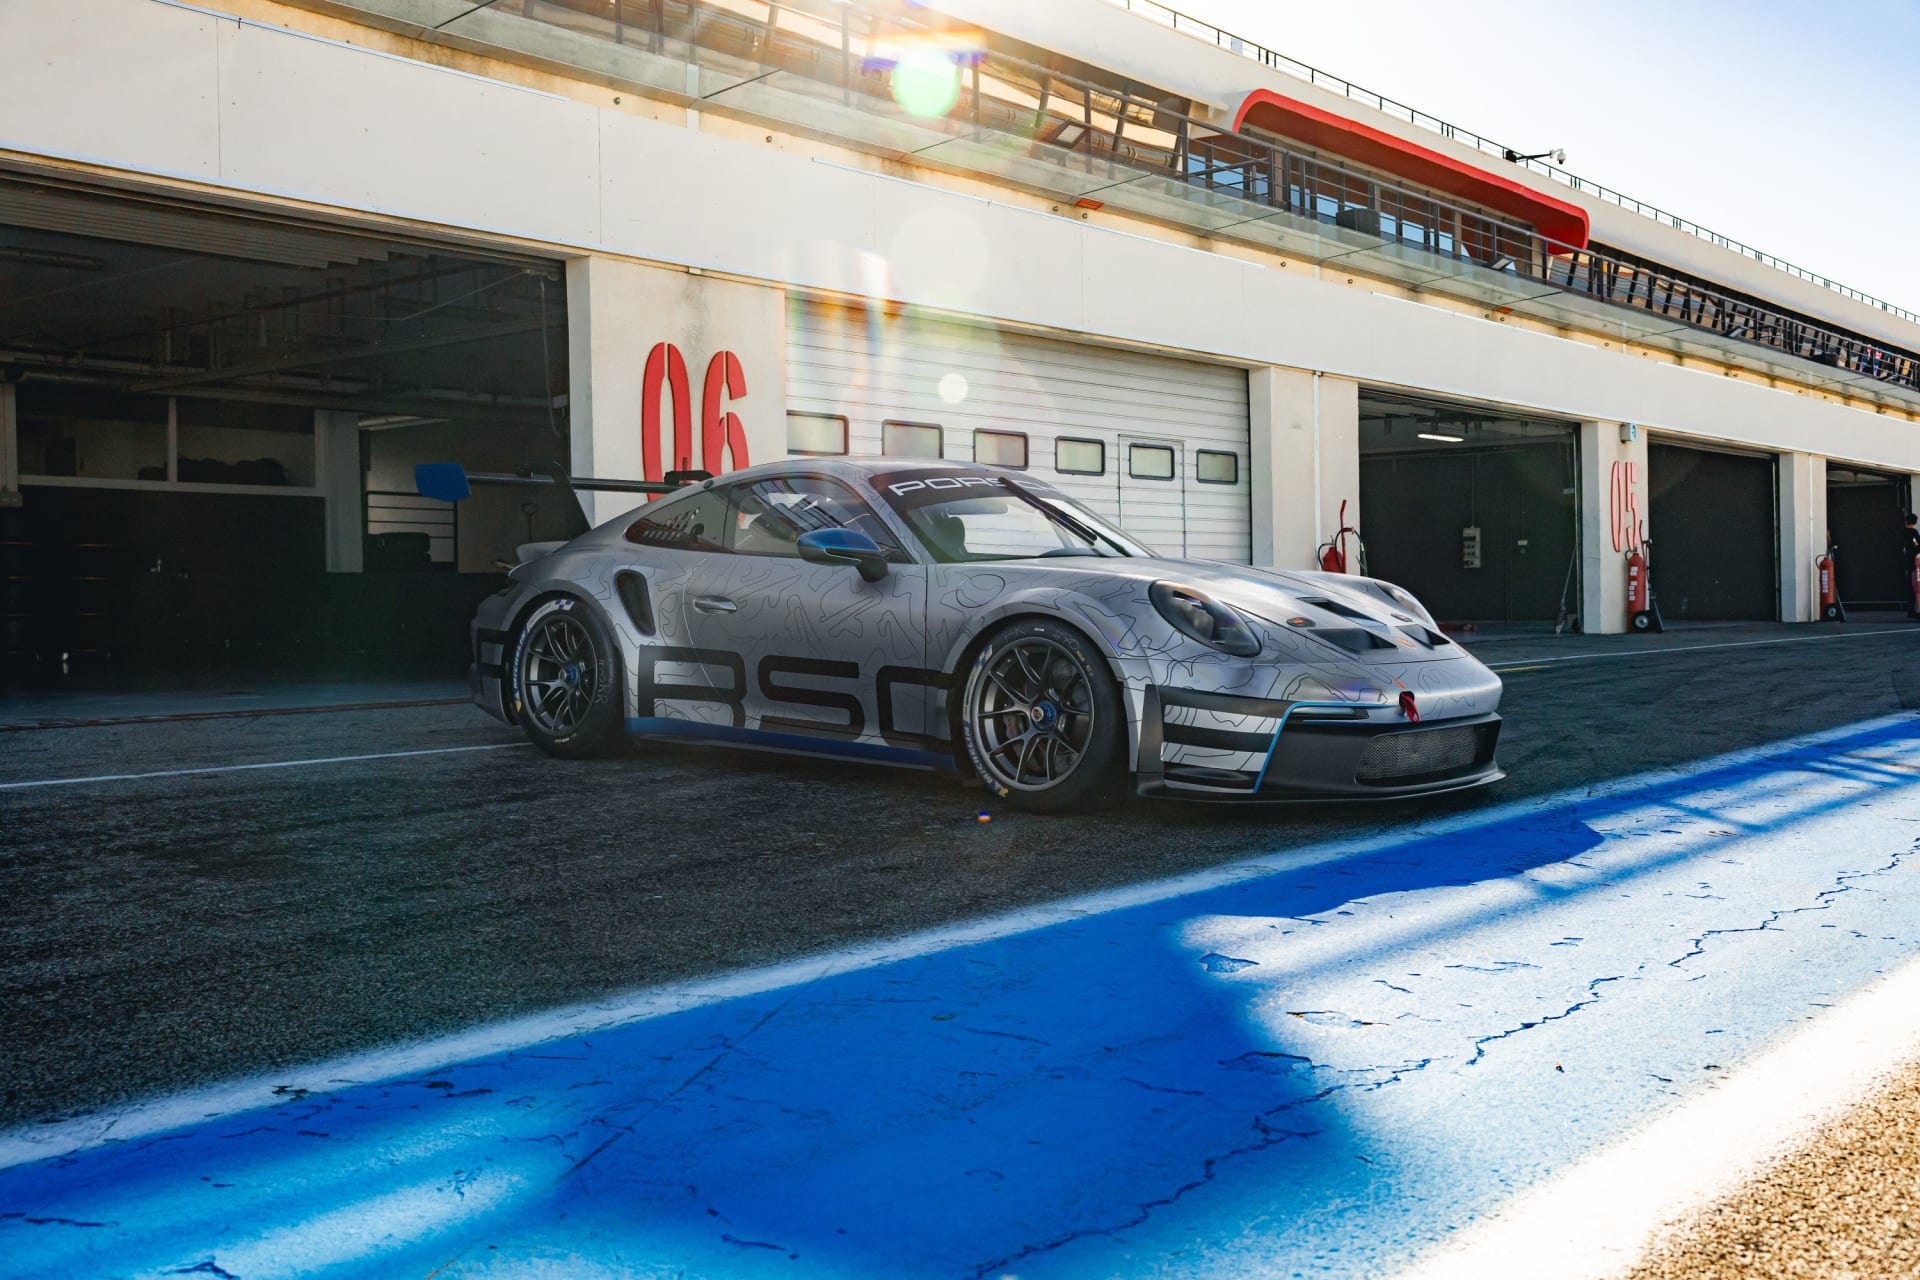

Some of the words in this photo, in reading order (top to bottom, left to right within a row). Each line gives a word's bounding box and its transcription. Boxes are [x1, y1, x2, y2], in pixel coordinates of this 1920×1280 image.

[641, 341, 750, 501] 06
[1610, 460, 1640, 553] 05
[963, 725, 994, 785] MICHELIN
